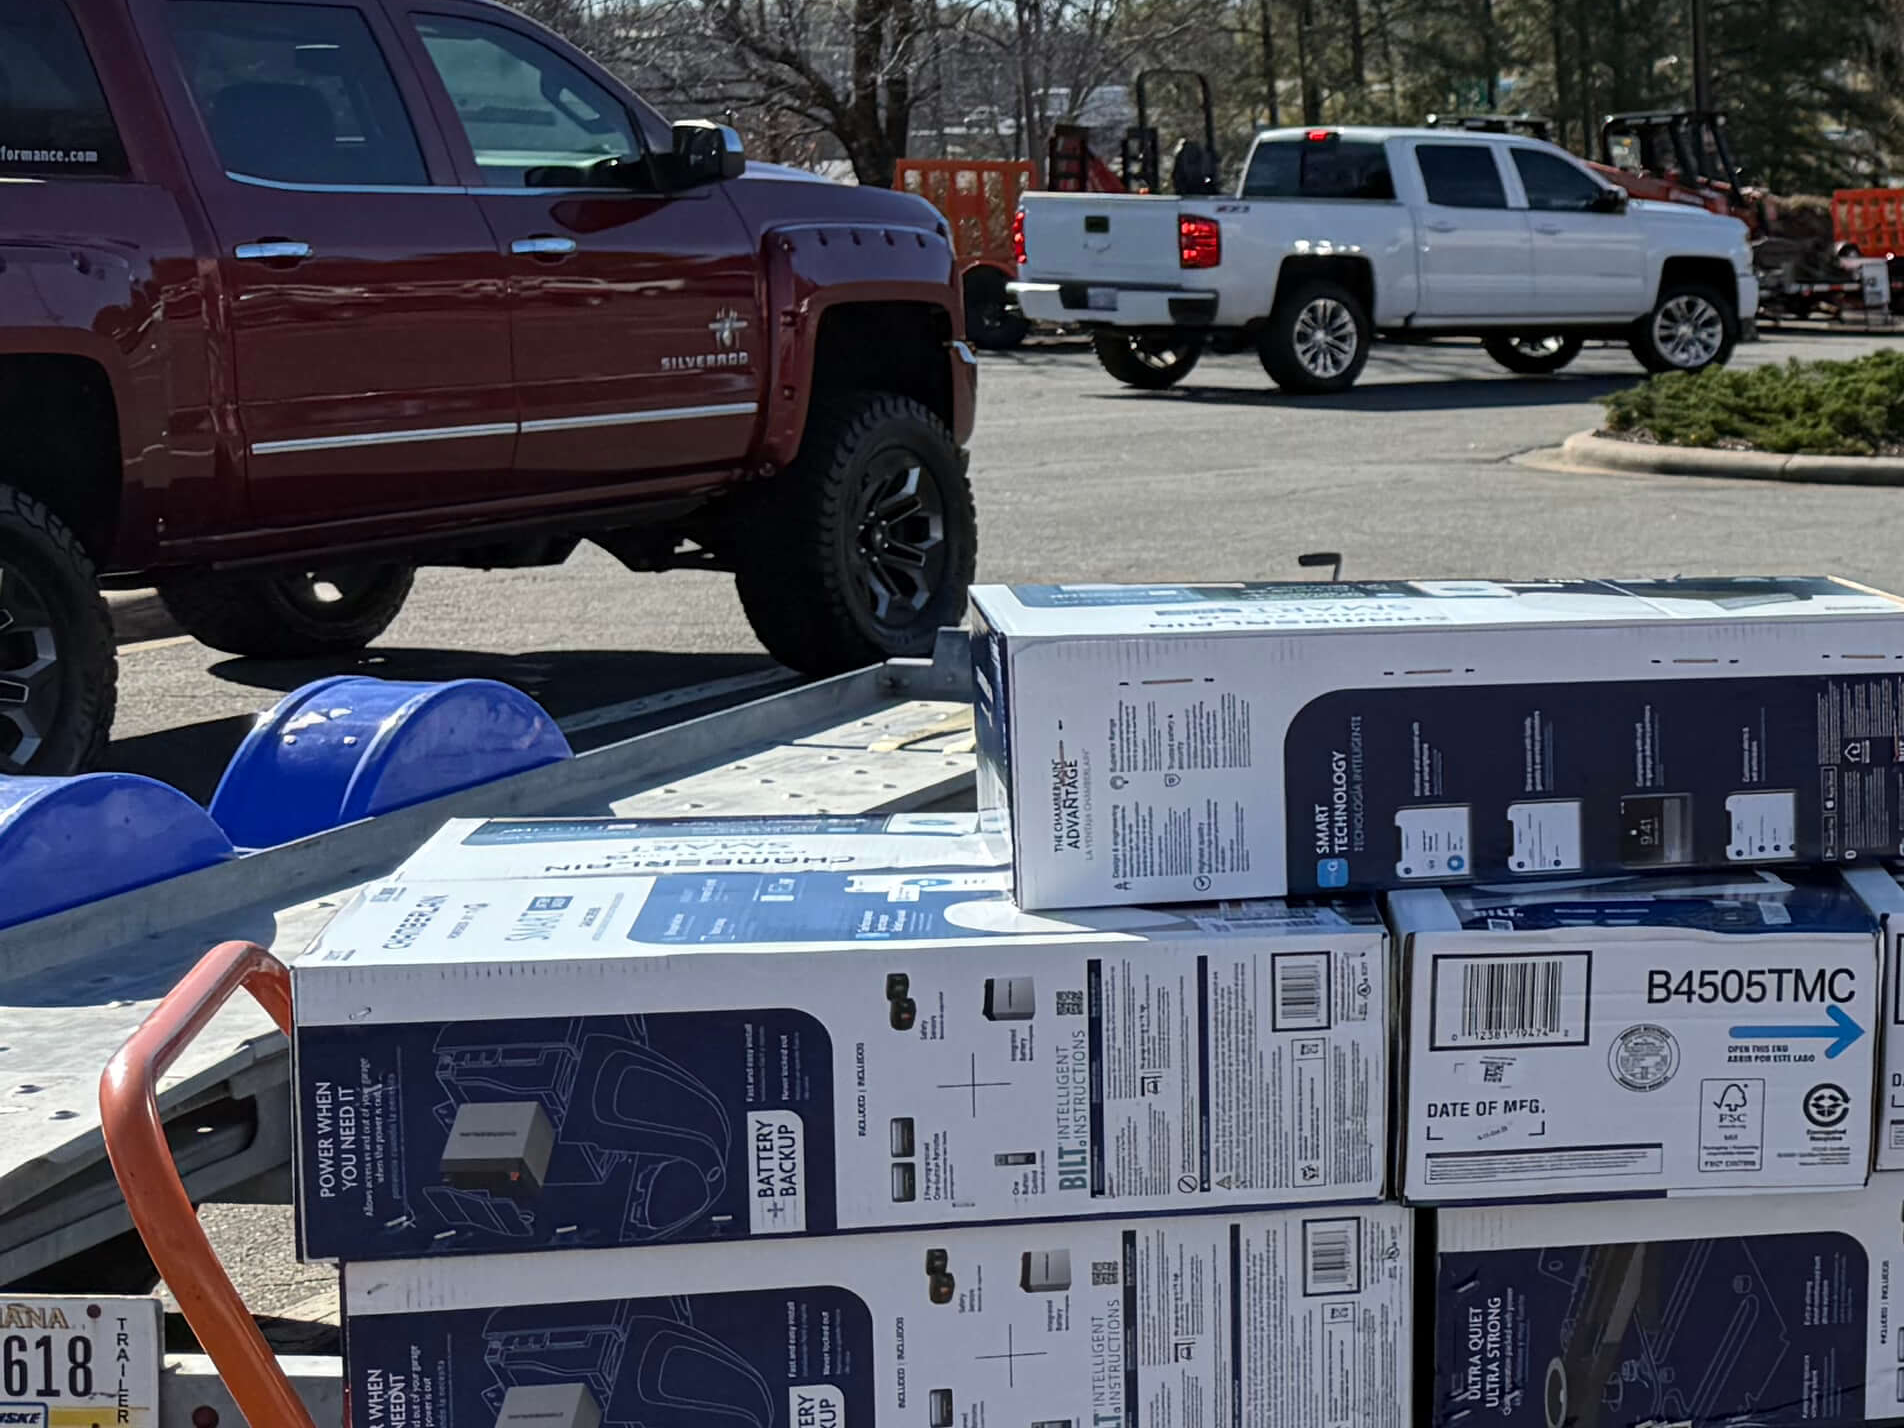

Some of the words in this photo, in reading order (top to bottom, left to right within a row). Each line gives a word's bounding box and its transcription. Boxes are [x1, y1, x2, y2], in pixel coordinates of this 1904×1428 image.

[661, 352, 748, 370] SILVERADO
[1063, 759, 1080, 849] ADVANTAGE
[1315, 804, 1329, 854] SMART
[1332, 751, 1349, 854] TECHNOLOGY
[1647, 968, 1856, 1004] B4505TMC
[315, 1082, 333, 1134] WHEN
[338, 1086, 354, 1102] IT
[1056, 1046, 1070, 1139] INTELLIGENT
[1072, 1030, 1087, 1139] INSTRUCTIONS
[1427, 1102, 1469, 1118] DATE
[1476, 1100, 1498, 1116] OF
[1503, 1099, 1546, 1115] MFG.
[339, 1104, 357, 1148] NEED
[317, 1137, 336, 1199] POWER
[340, 1152, 359, 1191] YOU
[755, 1120, 775, 1198] BATTERY
[778, 1124, 797, 1197] BACKUP
[1107, 1299, 1121, 1408] INSTRUCTIONS
[1468, 1306, 1484, 1351] QUIET
[1487, 1297, 1502, 1358] STRONG
[3, 1335, 93, 1397] 618
[116, 1318, 130, 1423] TRAILER
[1091, 1316, 1105, 1406] INTELLIGENT
[1467, 1355, 1481, 1400] ULTRA
[1485, 1362, 1500, 1408] ULTRA
[367, 1369, 385, 1420] WHEN
